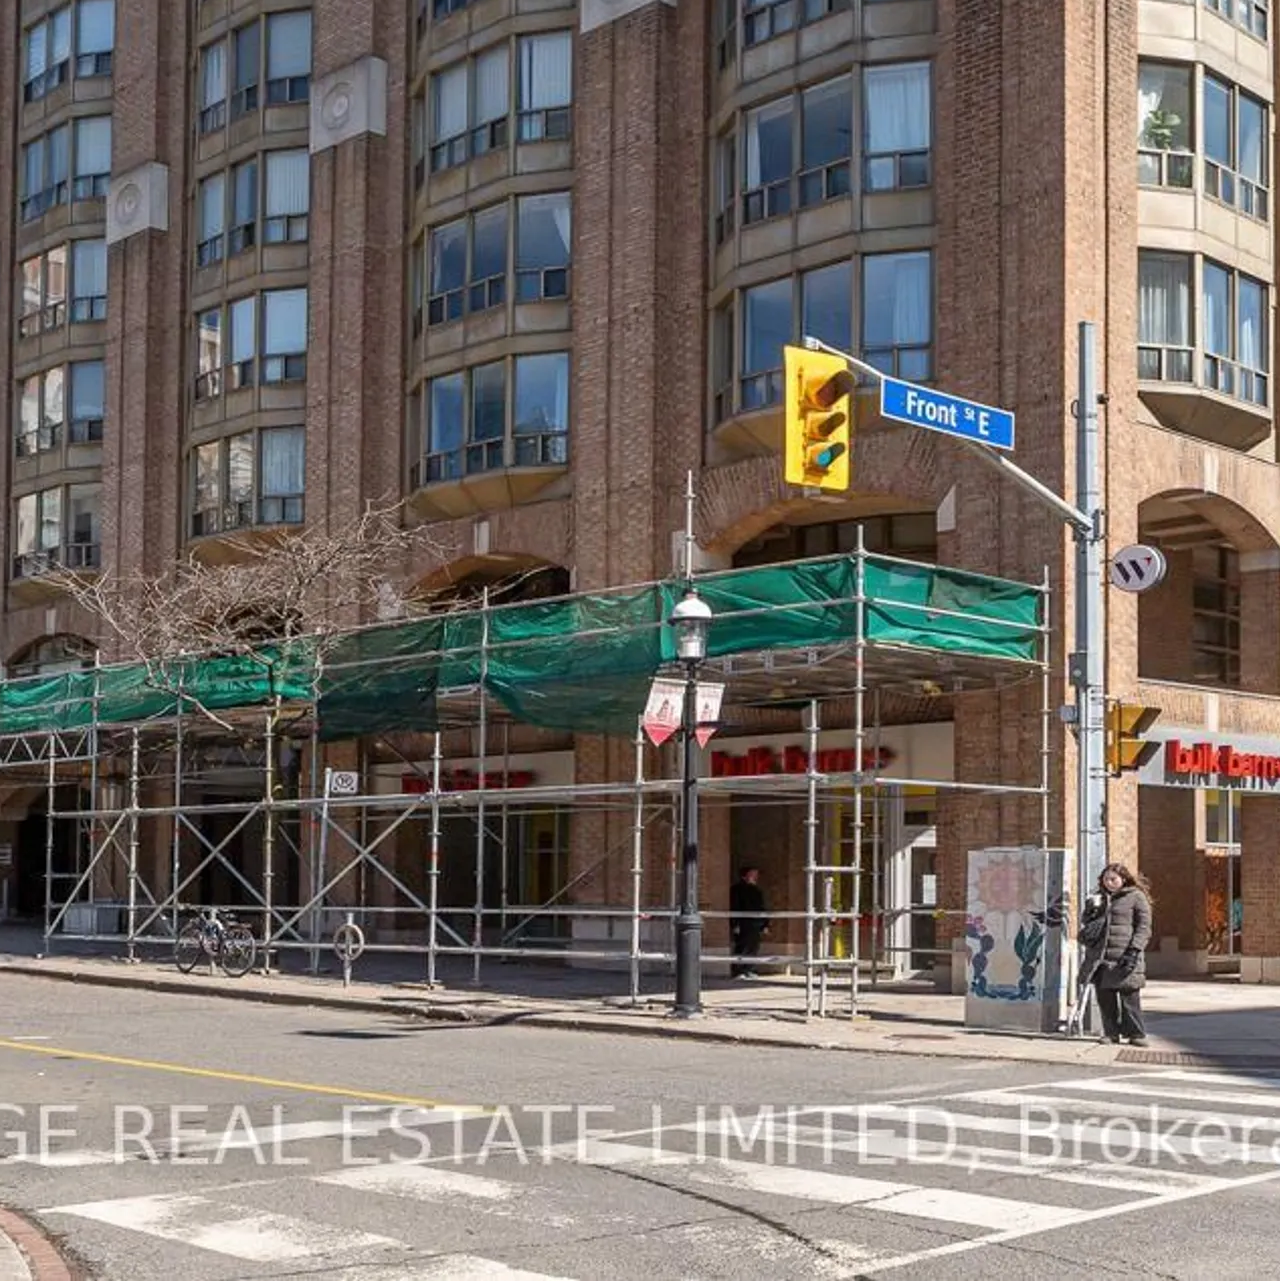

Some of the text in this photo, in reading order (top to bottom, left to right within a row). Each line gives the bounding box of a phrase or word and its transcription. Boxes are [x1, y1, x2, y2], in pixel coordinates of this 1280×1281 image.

[906, 390, 990, 435] Front St E
[1169, 740, 1280, 778] bulk barn
